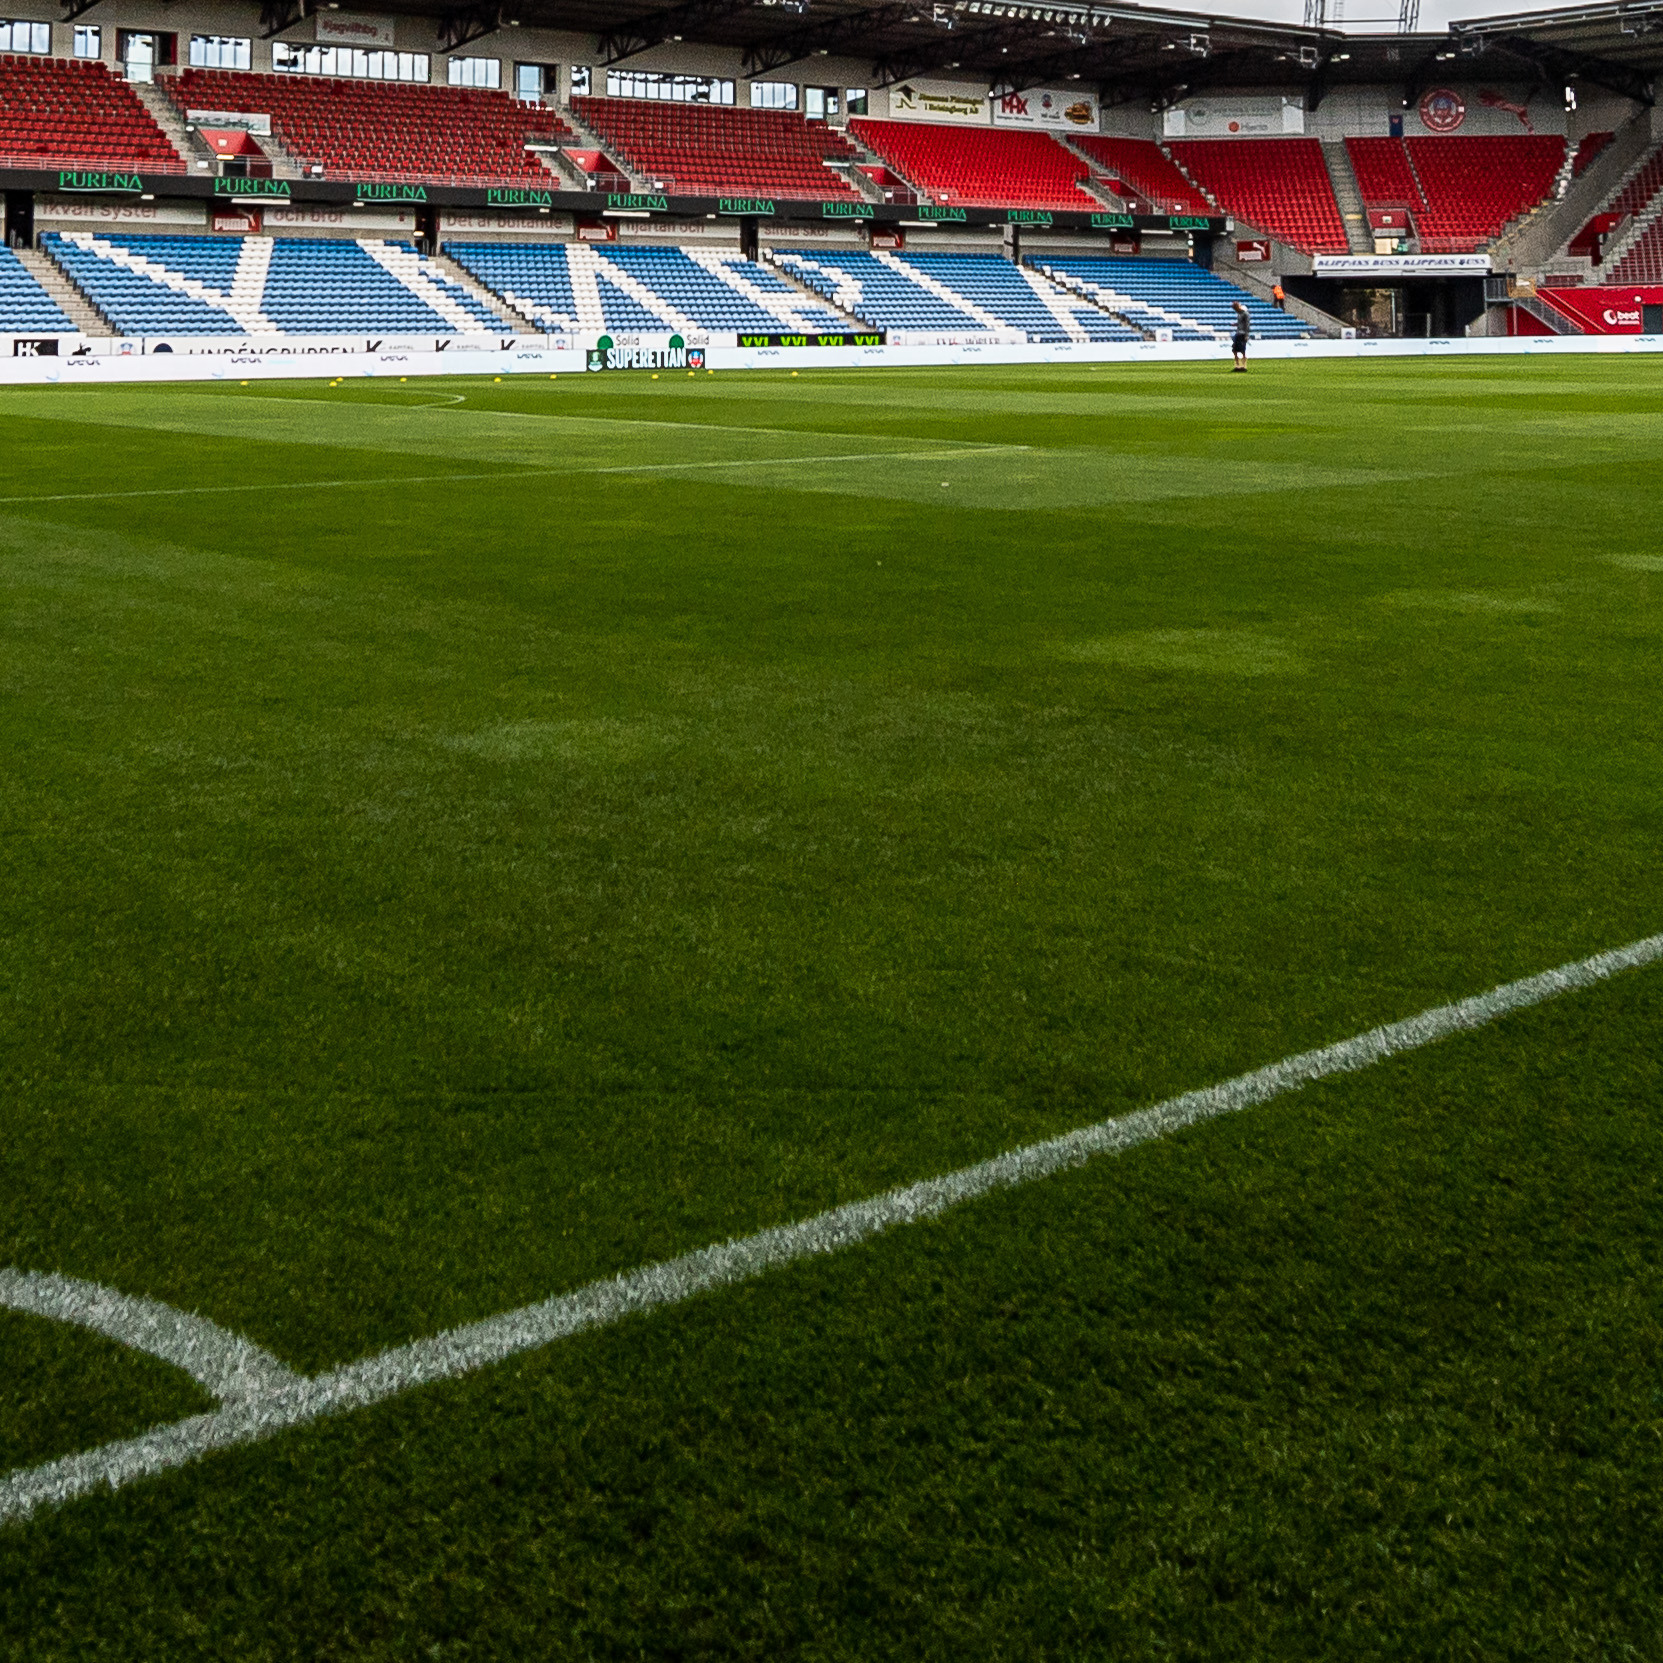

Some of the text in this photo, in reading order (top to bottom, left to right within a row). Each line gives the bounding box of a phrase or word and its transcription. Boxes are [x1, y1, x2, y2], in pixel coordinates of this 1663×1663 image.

[60, 172, 142, 188] PURENA
[215, 179, 290, 192] PURENA
[357, 185, 427, 198] PURENA
[488, 190, 551, 202] PURENA
[1617, 310, 1640, 321] beat
[616, 335, 640, 346] Solid
[687, 334, 710, 346] Solid
[17, 341, 42, 356] HK
[606, 347, 686, 369] SUPERETTAN
